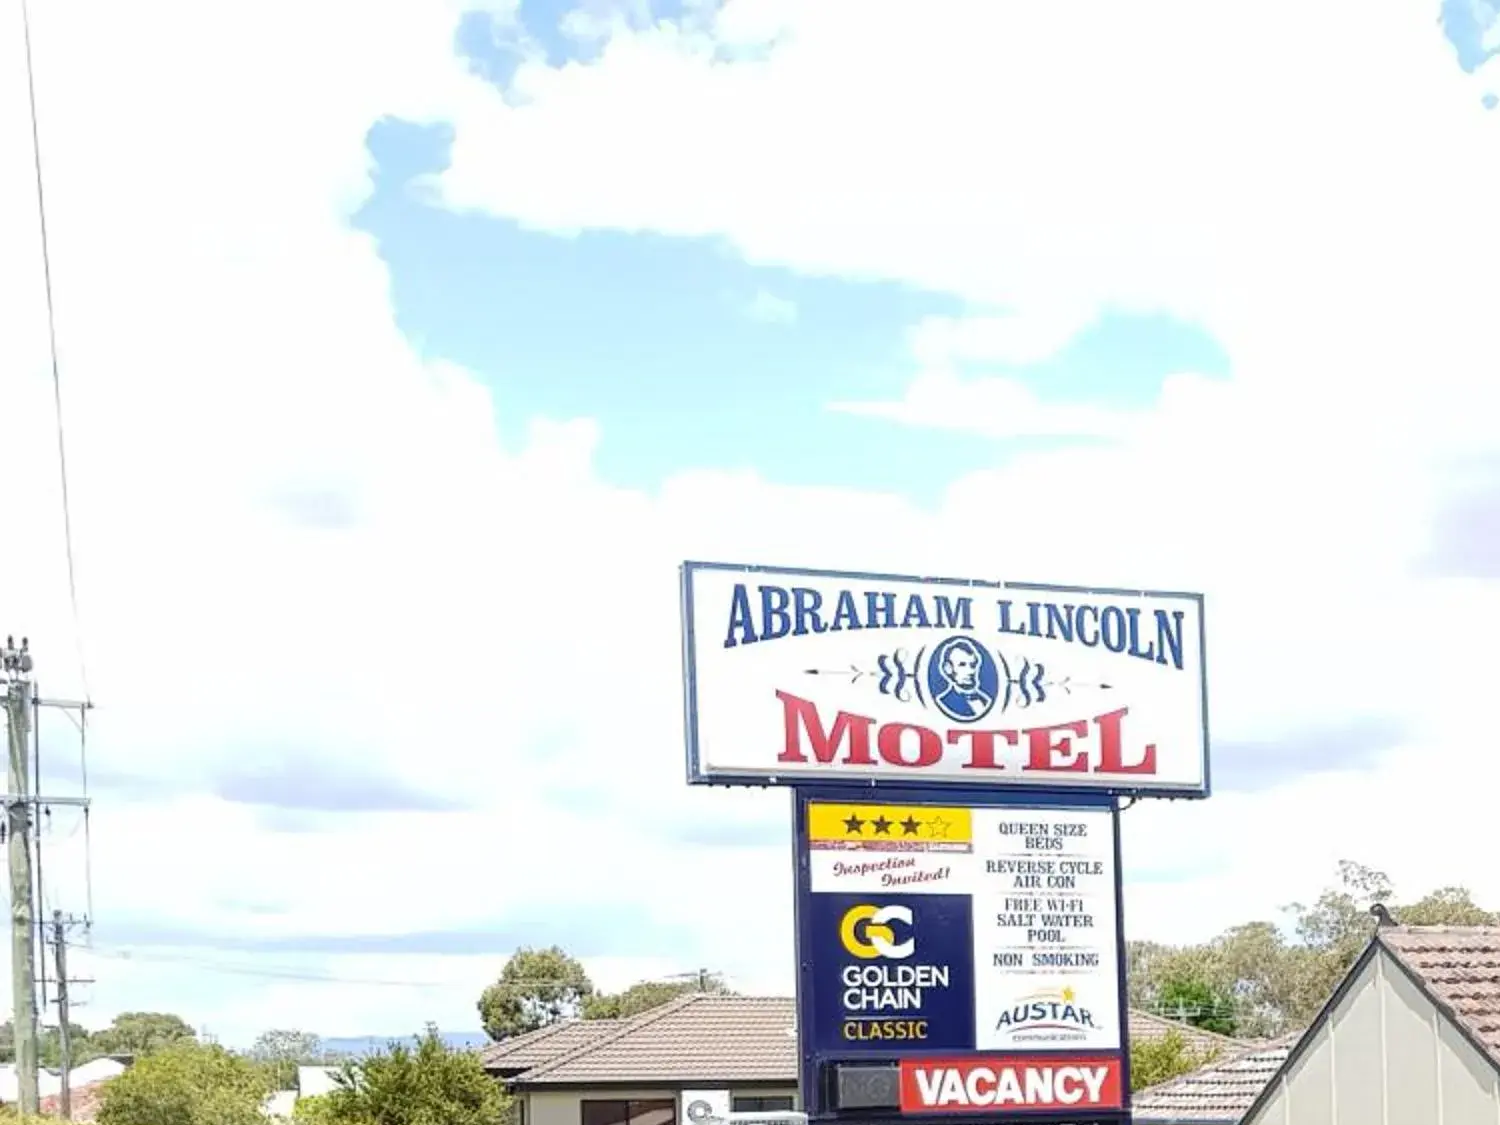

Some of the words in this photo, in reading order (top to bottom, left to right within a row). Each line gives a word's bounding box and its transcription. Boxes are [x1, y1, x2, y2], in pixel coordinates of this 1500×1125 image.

[724, 583, 973, 648] ABRAHAM
[997, 600, 1185, 670] LINCOLN
[775, 689, 1157, 775] MOTEL
[999, 822, 1049, 836] QUEEN
[1053, 823, 1087, 837] SIZE
[1025, 836, 1063, 850] BEDS
[833, 855, 916, 877] Inspection
[986, 860, 1055, 875] REVERSE
[1059, 861, 1104, 876] CYCLE
[881, 867, 951, 887] Invited!
[1013, 875, 1042, 889] AIR
[1047, 875, 1076, 889] CON
[1005, 897, 1042, 912] FREE
[997, 913, 1036, 927] SALT
[1041, 914, 1094, 928] WATER
[1027, 929, 1066, 943] POOL
[993, 953, 1023, 967] NON
[1032, 953, 1099, 967] SMOKING
[843, 964, 949, 988] GOLDEN
[843, 987, 921, 1010] CHAIN
[995, 1001, 1095, 1031] AUSTAR
[844, 1021, 929, 1040] CLASSIC
[914, 1066, 1109, 1106] VACANCY
